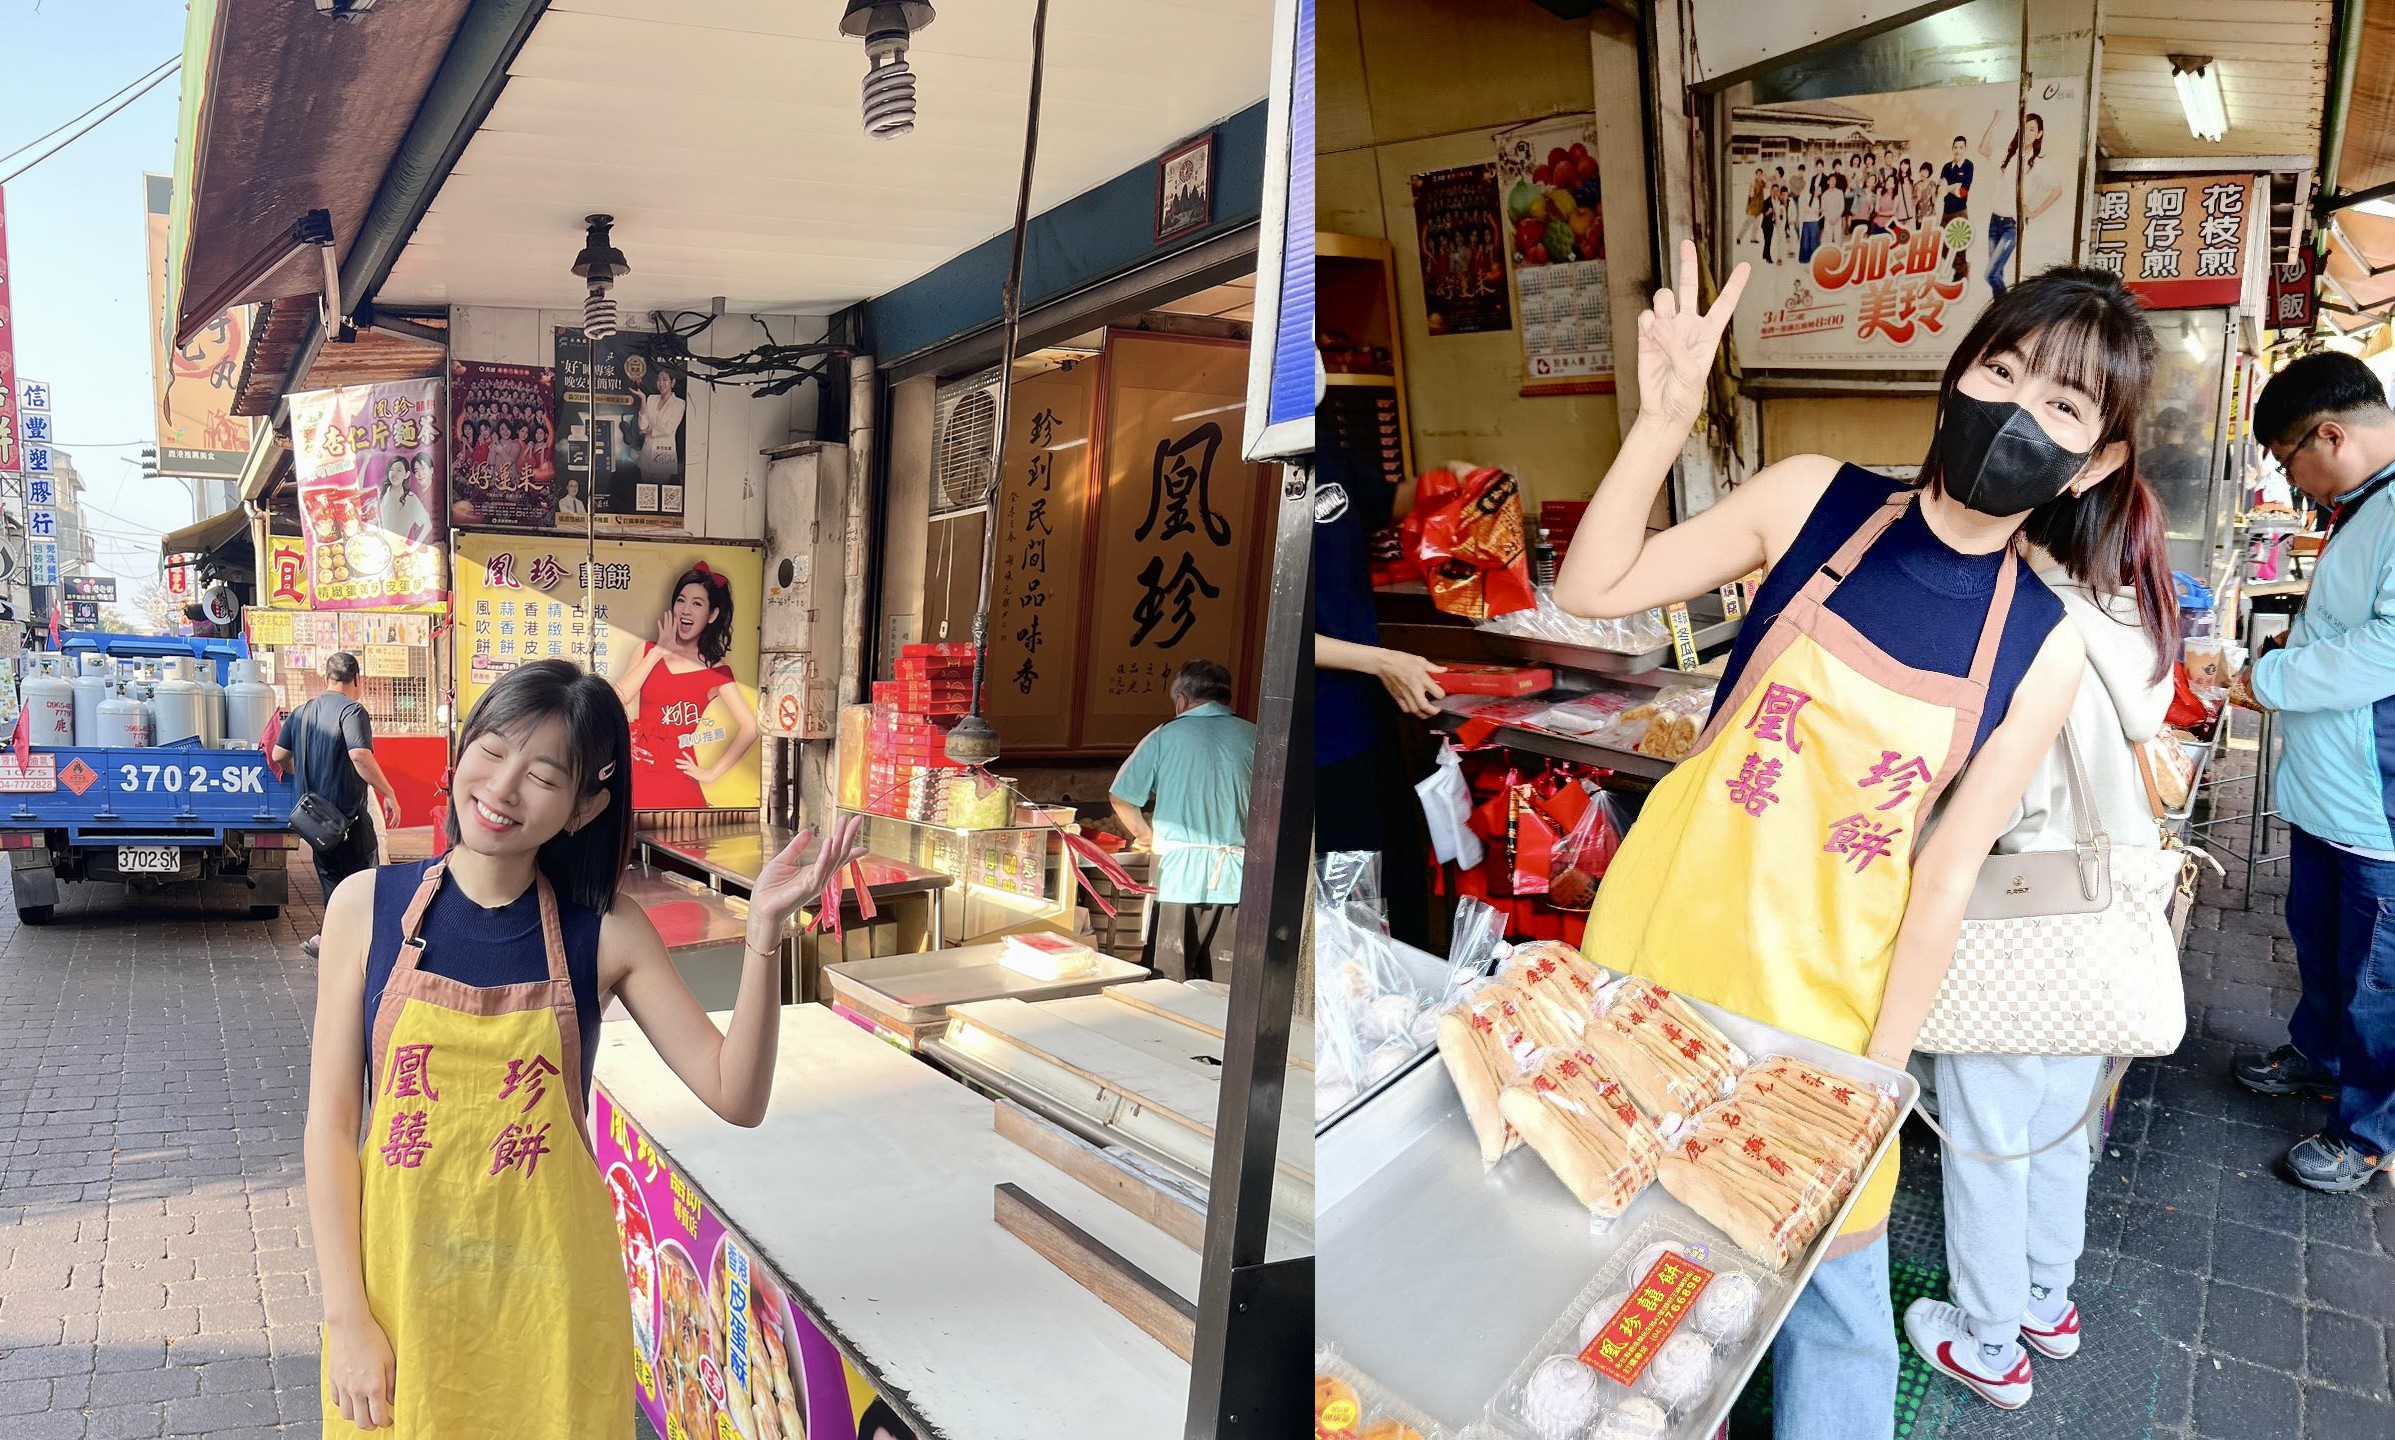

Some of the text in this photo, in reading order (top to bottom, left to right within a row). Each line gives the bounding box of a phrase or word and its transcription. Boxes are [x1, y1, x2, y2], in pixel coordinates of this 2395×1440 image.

[1813, 217, 1943, 290] 加油
[2091, 191, 2129, 278] 蝦仁煎
[2141, 188, 2187, 277] 蚵仔煎
[2196, 184, 2246, 277] 花枝煎
[1857, 275, 1964, 344] 美玲
[323, 415, 442, 456] 杏仁片麵茶
[373, 396, 415, 419] 凰珍
[23, 384, 54, 535] 信豐塑膠行
[167, 450, 216, 461] 鹿港推薦美食
[1012, 408, 1063, 695] 珍到民間品味香
[1128, 420, 1232, 650] 凰珍
[273, 544, 306, 604] 宜
[483, 552, 572, 590] 凰珍
[475, 600, 491, 654] 風吹餅
[499, 601, 515, 655] 蒜香餅
[523, 602, 539, 663] 香港皮
[547, 603, 562, 656] 精緻蛋
[571, 604, 587, 668] 古早味
[594, 604, 609, 676] 狀元魯肉
[0, 756, 48, 766] 液化油氣
[120, 764, 265, 794] 3702-SK
[673, 1196, 698, 1241] 專賣店
[1599, 1262, 1685, 1363] 凰珍囍餅
[1658, 1274, 1702, 1327] 7766898
[702, 1359, 723, 1398] 正宗
